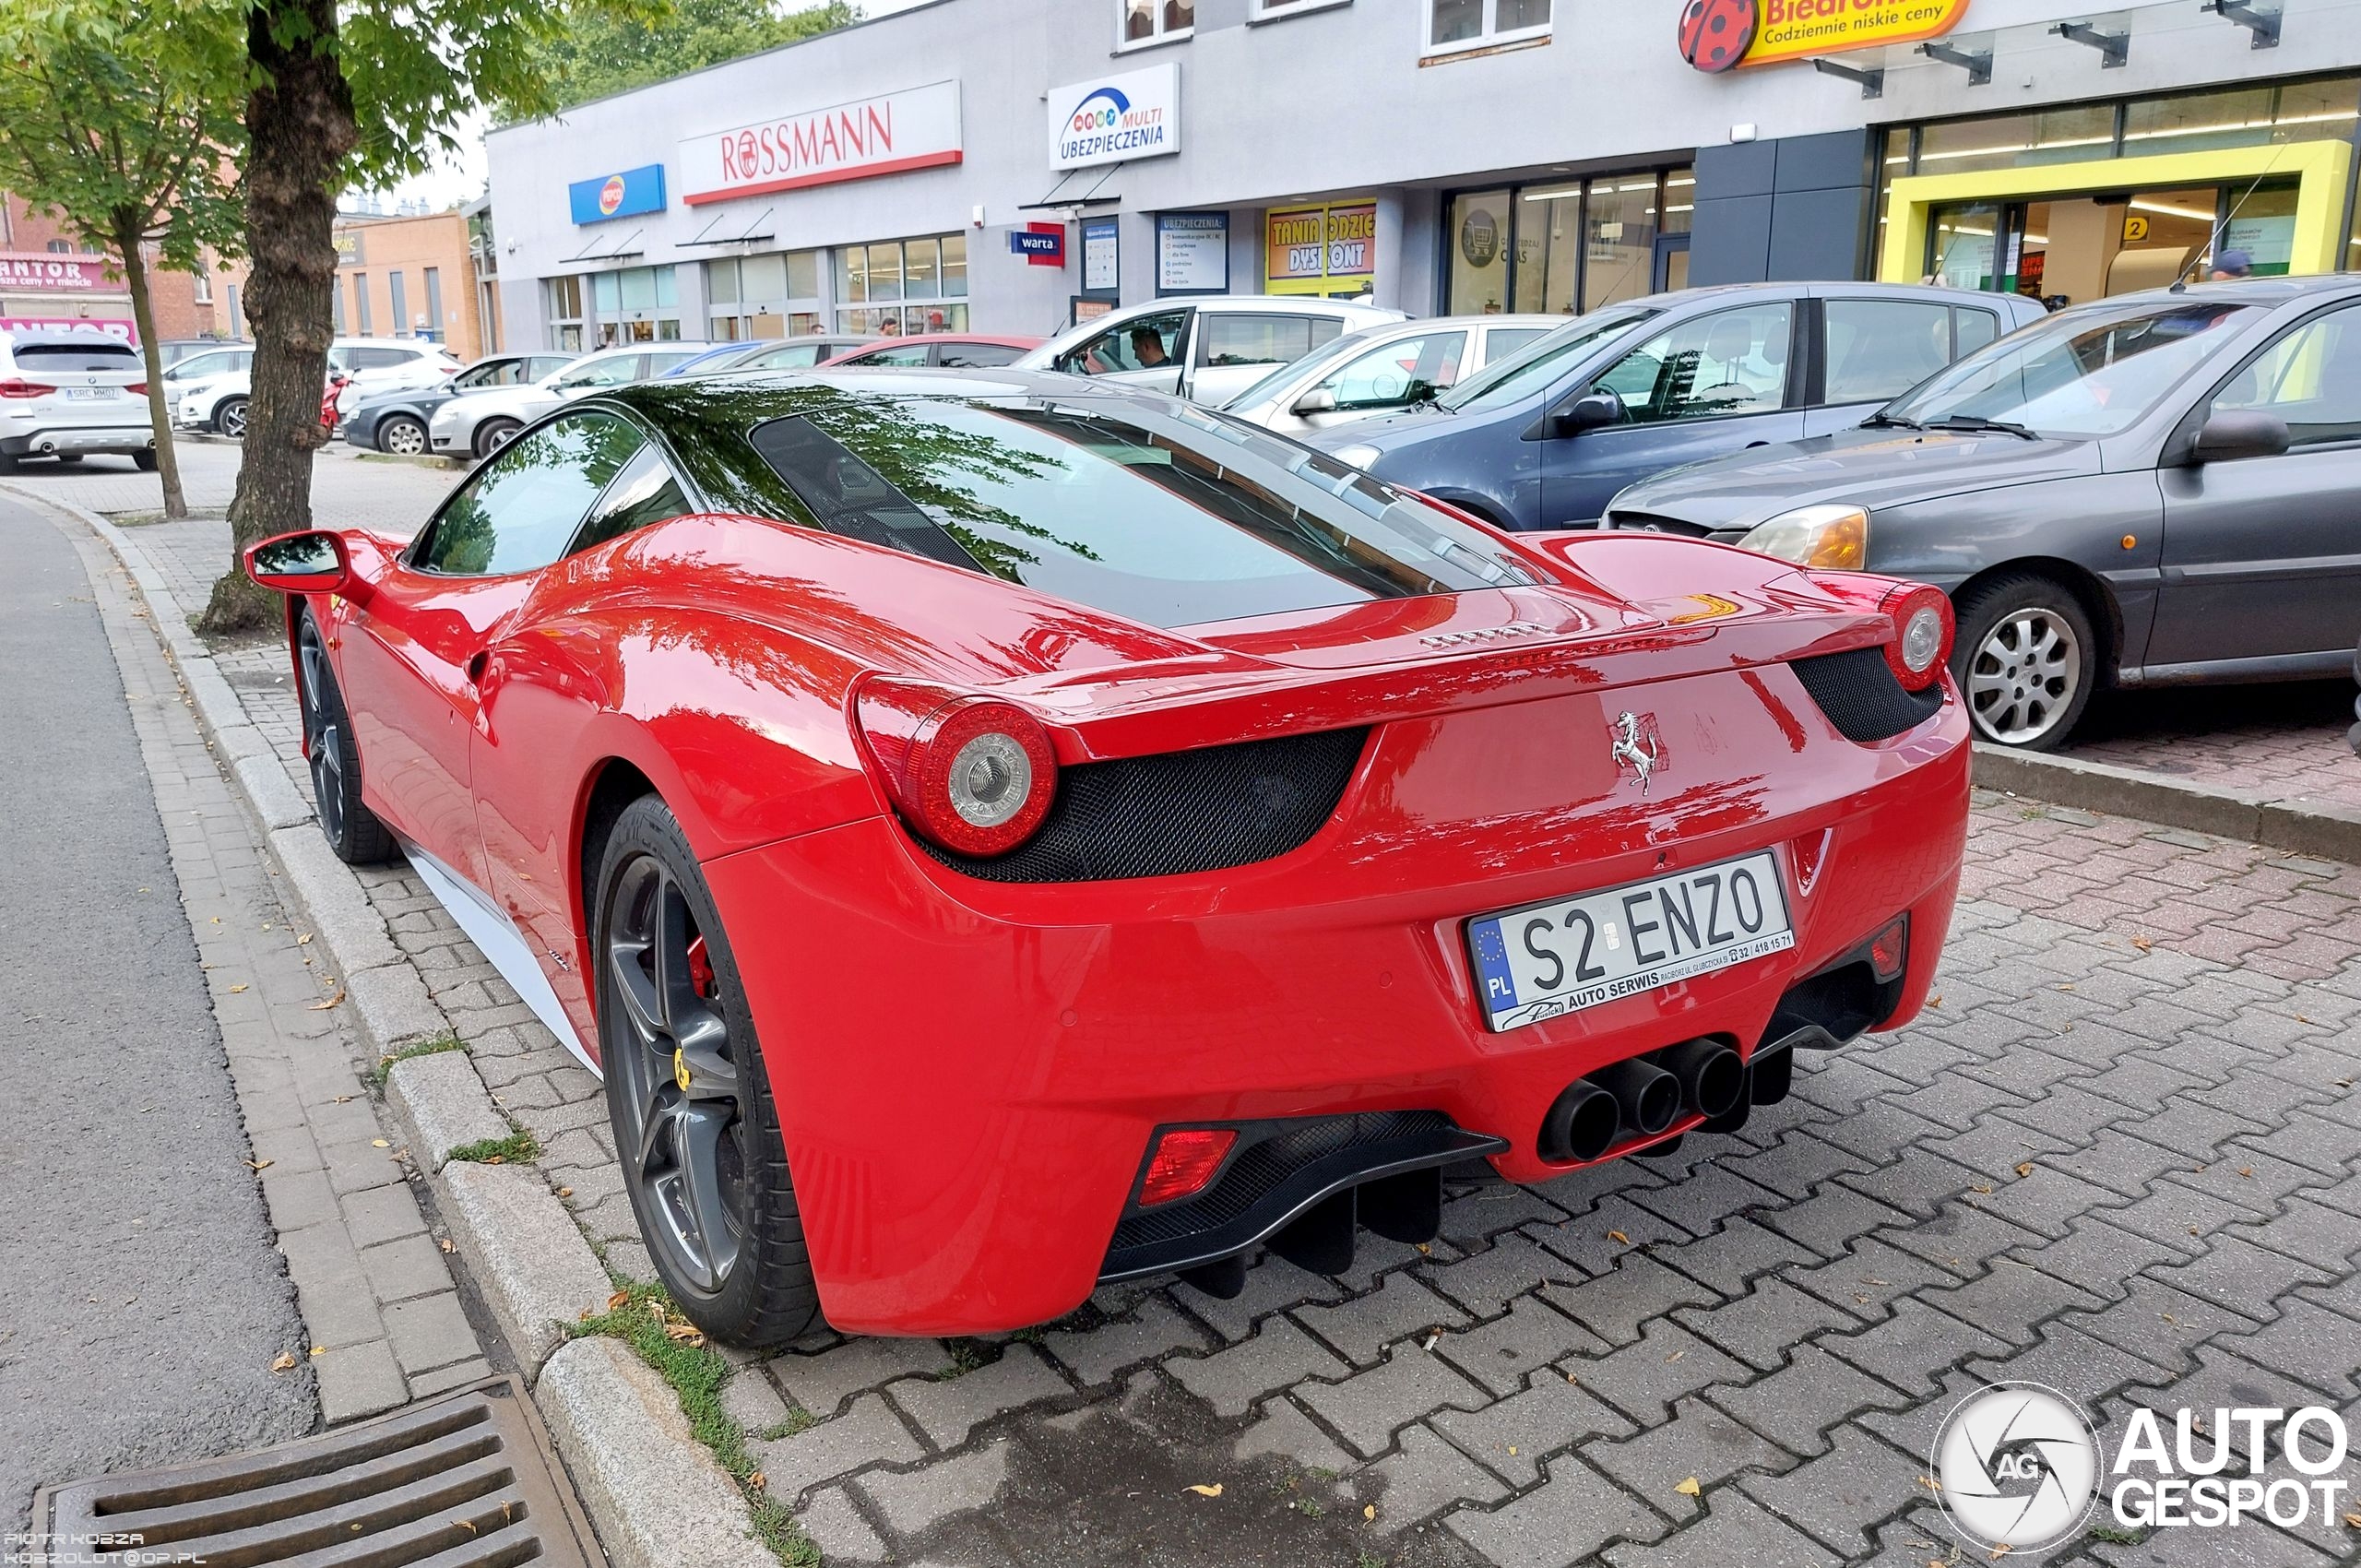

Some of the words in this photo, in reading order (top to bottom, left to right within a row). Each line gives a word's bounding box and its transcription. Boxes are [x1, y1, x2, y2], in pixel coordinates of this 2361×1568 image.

[1764, 19, 1847, 44] Codziennie
[1853, 11, 1900, 30] niskie
[1905, 6, 1944, 24] ceny
[1121, 108, 1162, 129] MULTI
[721, 101, 892, 182] ROSSMANN
[1061, 125, 1163, 160] UBEZPIECZENIA
[1273, 218, 1320, 246] TANIA
[1328, 213, 1375, 242] ODZIE
[2130, 221, 2141, 236] 2
[1501, 249, 1527, 264] CAS
[19, 278, 42, 287] ceny
[1523, 909, 1606, 991] S2
[1622, 867, 1763, 966] ENZO
[1488, 976, 1512, 999] PL
[1568, 987, 1607, 1010] AUTO
[1608, 971, 1660, 998] SERWIS
[1739, 947, 1750, 959] 32
[1754, 941, 1770, 954] 418
[1771, 938, 1781, 949] 15
[1781, 934, 1791, 946] 71
